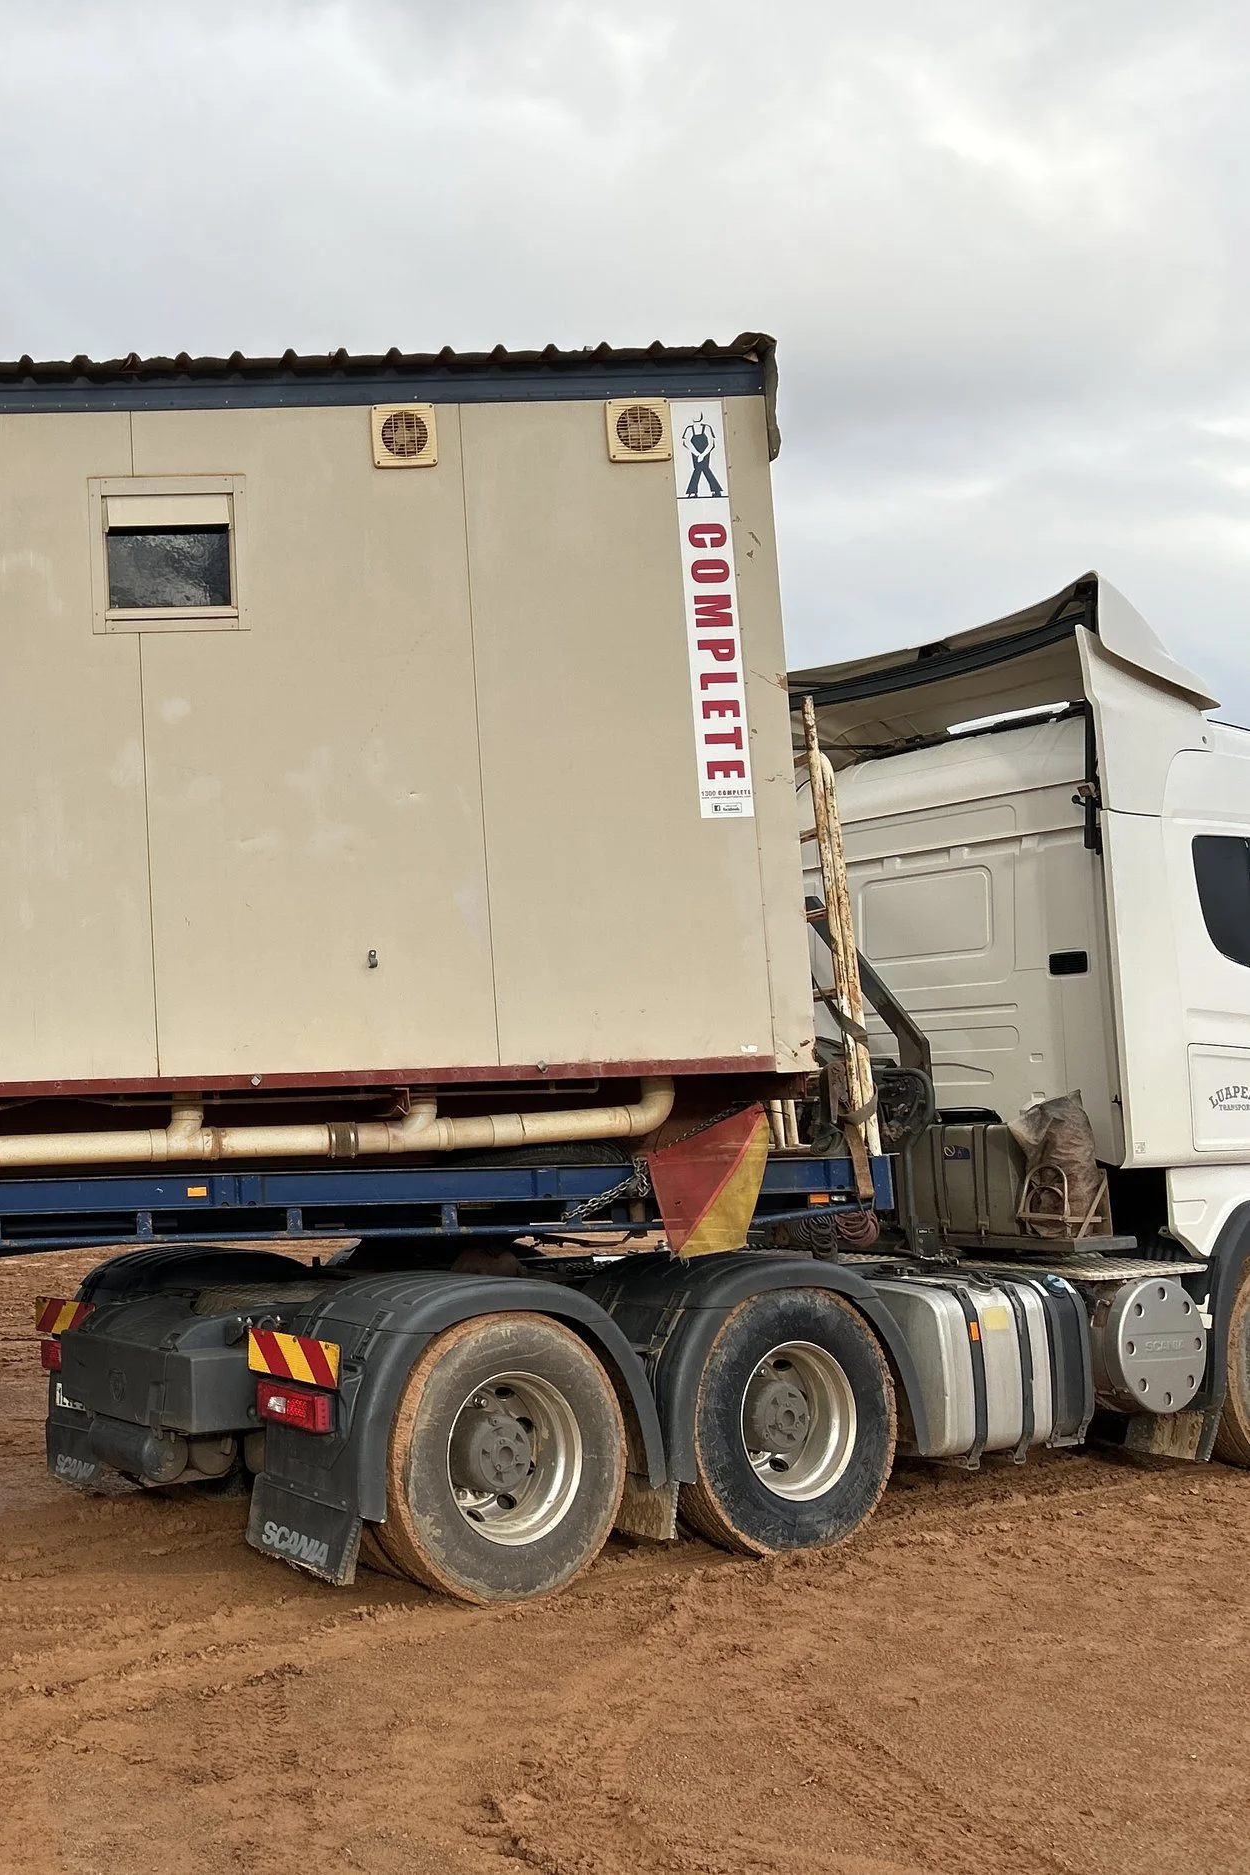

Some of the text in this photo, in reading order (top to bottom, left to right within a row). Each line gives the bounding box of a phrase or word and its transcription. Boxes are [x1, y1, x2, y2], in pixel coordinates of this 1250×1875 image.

[688, 523, 746, 780] COMPLETE
[1209, 1085, 1250, 1109] LUAPE
[56, 1453, 96, 1480] SCANIA
[262, 1521, 329, 1567] SCANIA
